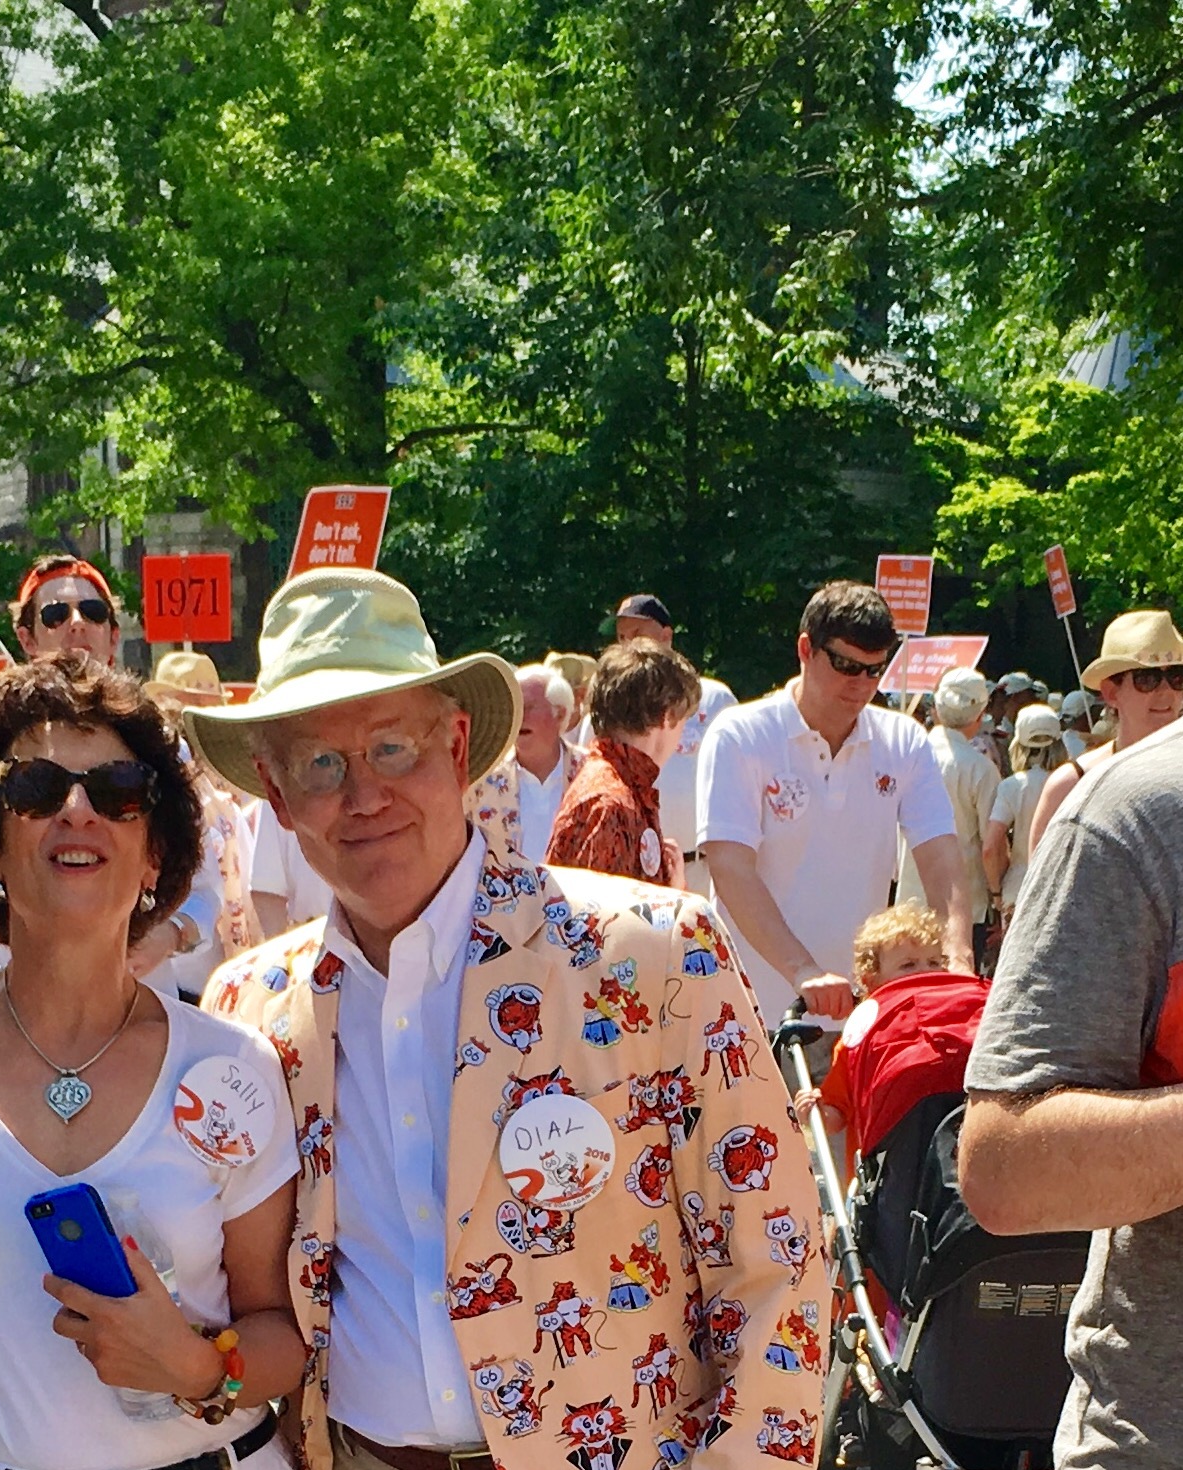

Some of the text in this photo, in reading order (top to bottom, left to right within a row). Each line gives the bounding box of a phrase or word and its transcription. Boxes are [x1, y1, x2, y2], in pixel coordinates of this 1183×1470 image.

[155, 577, 220, 617] 1971
[221, 1064, 265, 1116] Sally
[515, 1117, 584, 1151] DIAL
[771, 1222, 791, 1236] 66
[543, 1316, 559, 1327] 66
[480, 1370, 498, 1386] 66
[639, 1369, 654, 1380] 66
